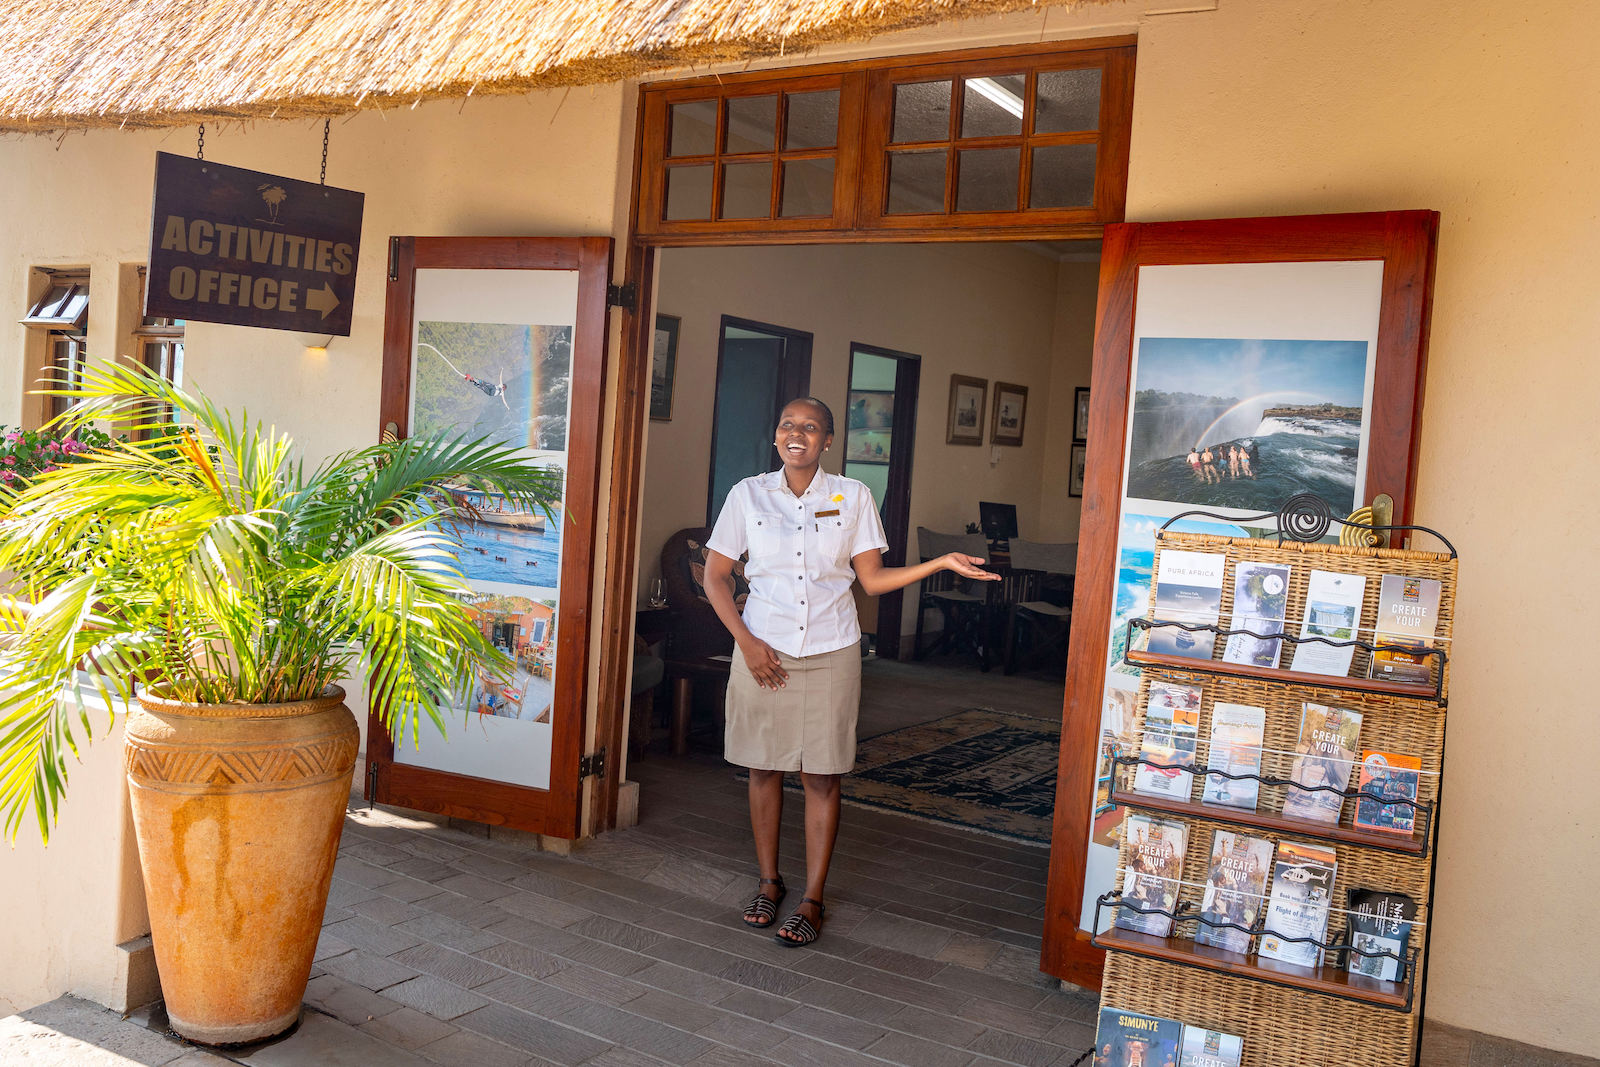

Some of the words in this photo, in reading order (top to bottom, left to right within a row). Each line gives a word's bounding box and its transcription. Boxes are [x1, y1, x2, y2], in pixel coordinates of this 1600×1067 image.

[161, 215, 353, 275] ACTIVITIES
[168, 266, 299, 312] OFFICE
[1167, 567, 1187, 576] PURE
[1188, 569, 1215, 577] AFRICA
[1392, 603, 1427, 617] CREATE
[1395, 616, 1421, 627] YOUR
[1312, 729, 1346, 746] CREATE
[1315, 741, 1340, 756] YOUR
[1138, 844, 1170, 859] CREATE
[1142, 854, 1165, 868] YOUR
[1220, 856, 1254, 873] CREATE
[1223, 869, 1248, 883] YOUR
[1276, 906, 1291, 915] Flight
[1299, 912, 1319, 921] Angels
[1118, 1015, 1159, 1032] SIMUNYE
